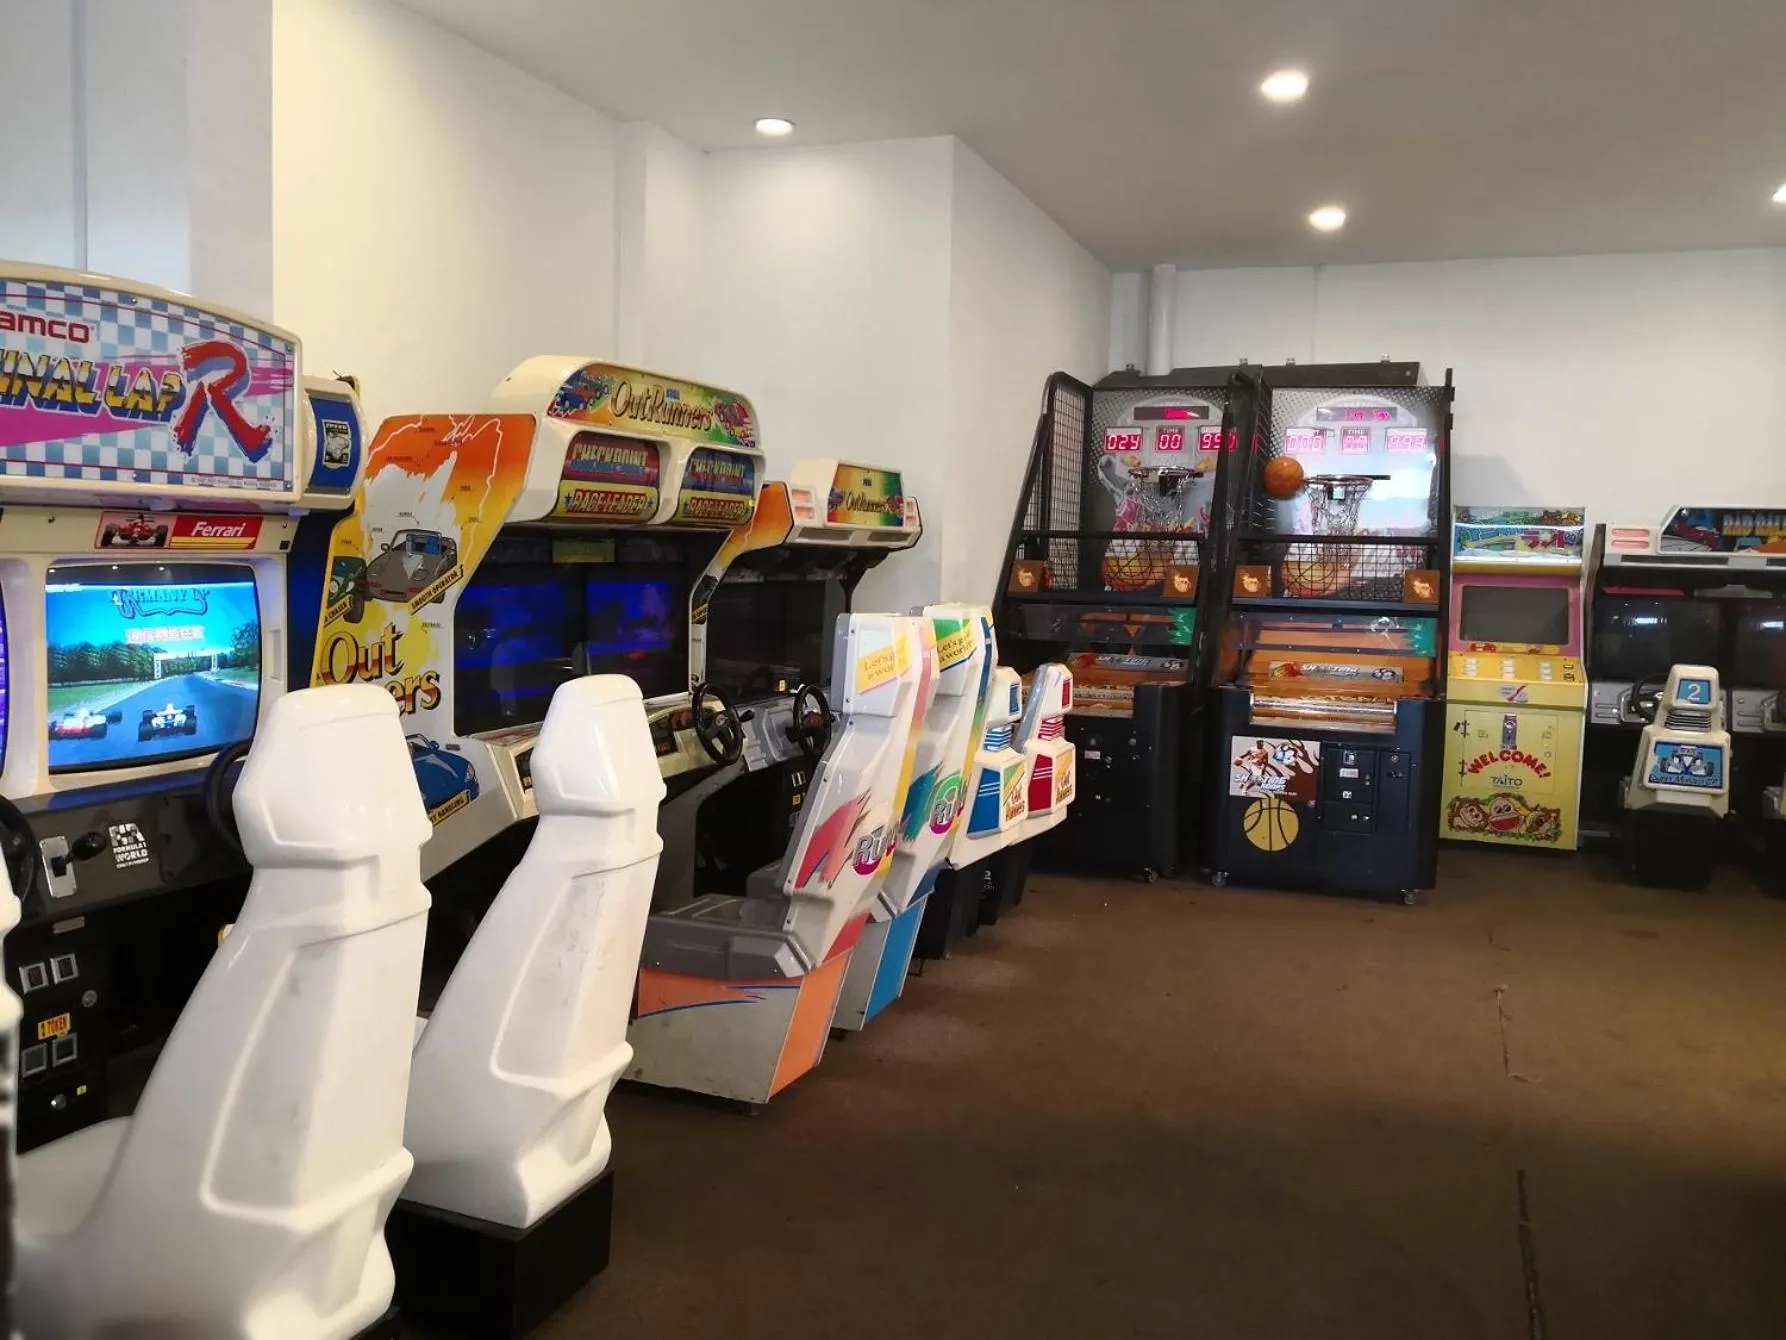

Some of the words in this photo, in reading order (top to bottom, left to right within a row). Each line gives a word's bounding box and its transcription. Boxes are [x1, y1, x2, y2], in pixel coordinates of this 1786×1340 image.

[0, 311, 89, 343] amco
[0, 349, 98, 406] INAL
[104, 366, 183, 414] LAP
[190, 521, 247, 537] Ferrari
[431, 569, 459, 594] OPERATOR
[321, 622, 404, 686] Out
[1688, 683, 1702, 700] 2
[1467, 750, 1551, 778] WELCOME!
[115, 849, 148, 862] WORLD
